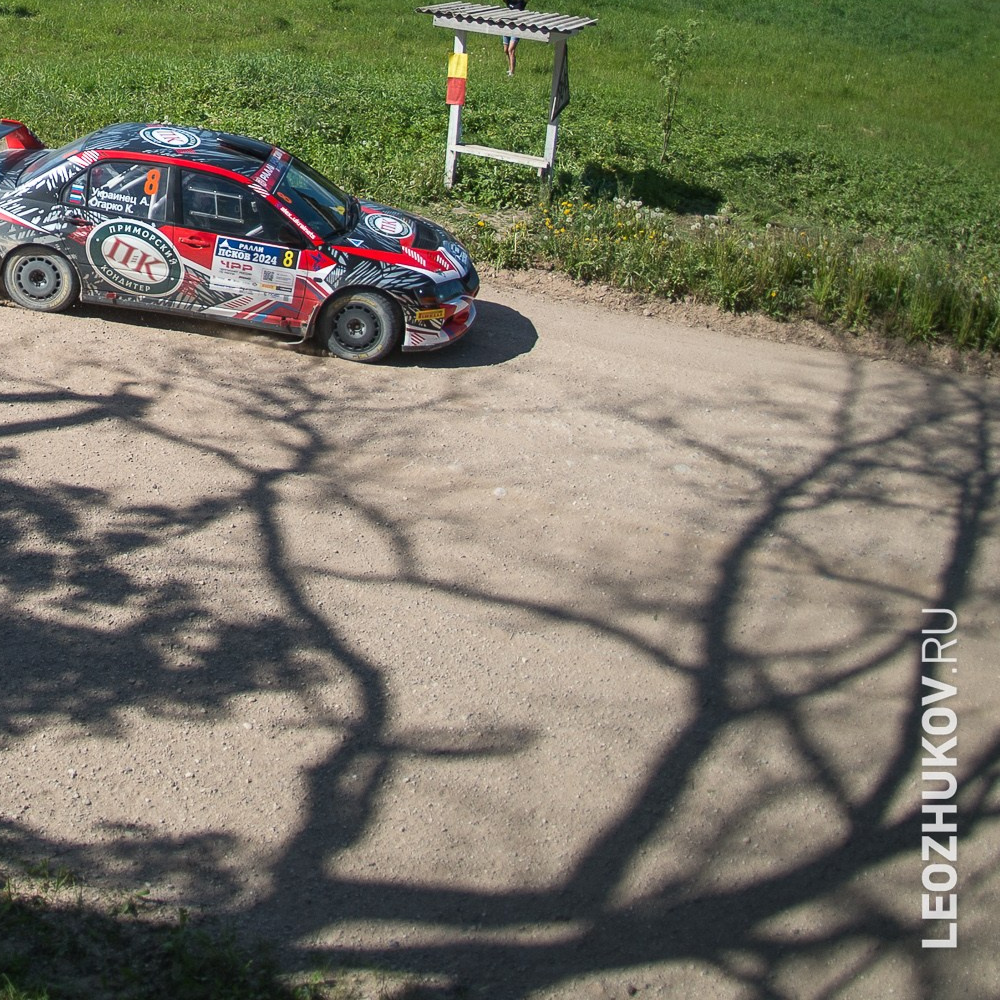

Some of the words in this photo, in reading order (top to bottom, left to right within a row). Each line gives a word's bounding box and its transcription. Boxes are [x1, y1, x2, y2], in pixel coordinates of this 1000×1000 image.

[144, 169, 161, 196] 8
[90, 196, 123, 211] Огарко
[91, 186, 137, 206] Украинец
[108, 224, 178, 266] ПРИМОРСКИЙ
[238, 243, 264, 253] РАЛЛИ
[104, 236, 167, 282] ПК
[217, 248, 251, 261] ПСКОВ
[252, 253, 278, 266] 2024
[220, 260, 253, 271] ЧРР
[282, 250, 294, 268] 8
[100, 264, 151, 292] КОНДИТЕР
